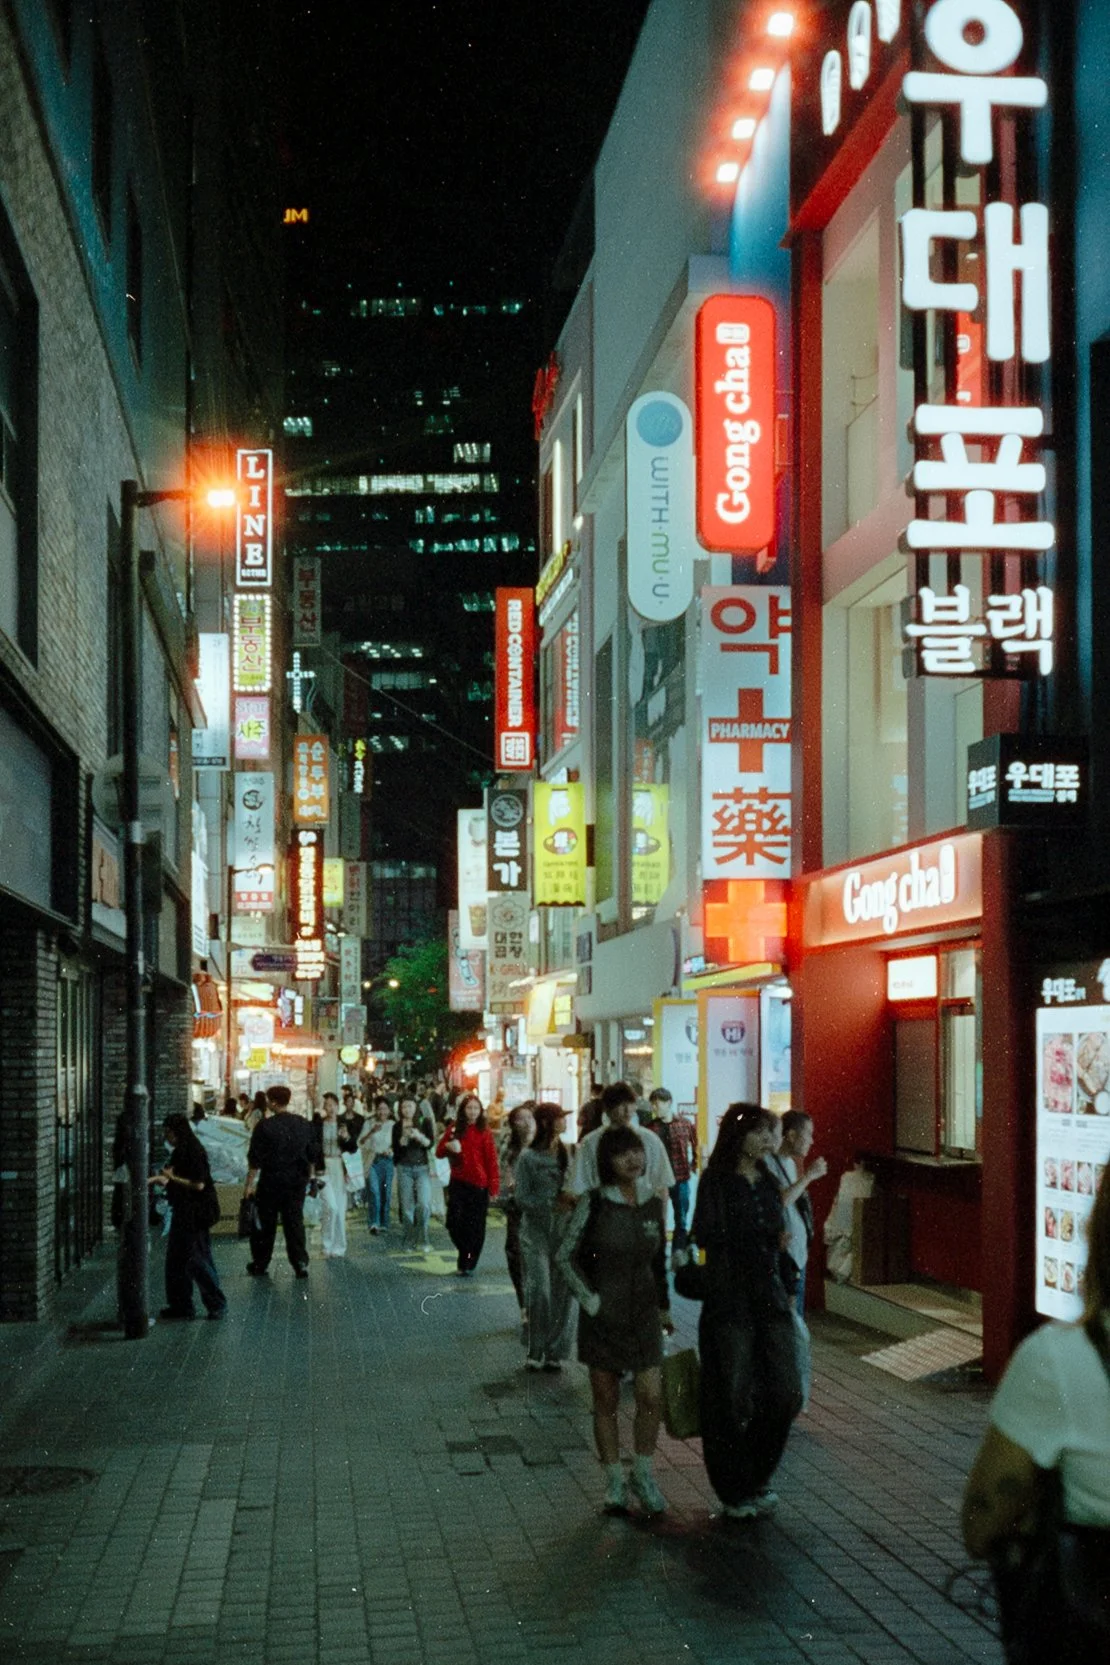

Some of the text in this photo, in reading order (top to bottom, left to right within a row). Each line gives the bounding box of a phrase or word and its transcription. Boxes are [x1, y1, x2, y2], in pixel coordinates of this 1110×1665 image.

[715, 346, 751, 414] cha
[244, 456, 266, 566] LINE
[715, 419, 760, 524] Gong
[240, 617, 263, 672] 부동산
[507, 599, 523, 728] RED CONTAINER
[710, 595, 791, 676] 약
[905, 584, 1054, 677] 블랙
[238, 720, 266, 740] 사주
[710, 721, 791, 739] PHARMACY
[1005, 761, 1081, 789] 우대포
[711, 786, 792, 867] 藥
[842, 871, 898, 935] Gong
[898, 849, 941, 913] cha
